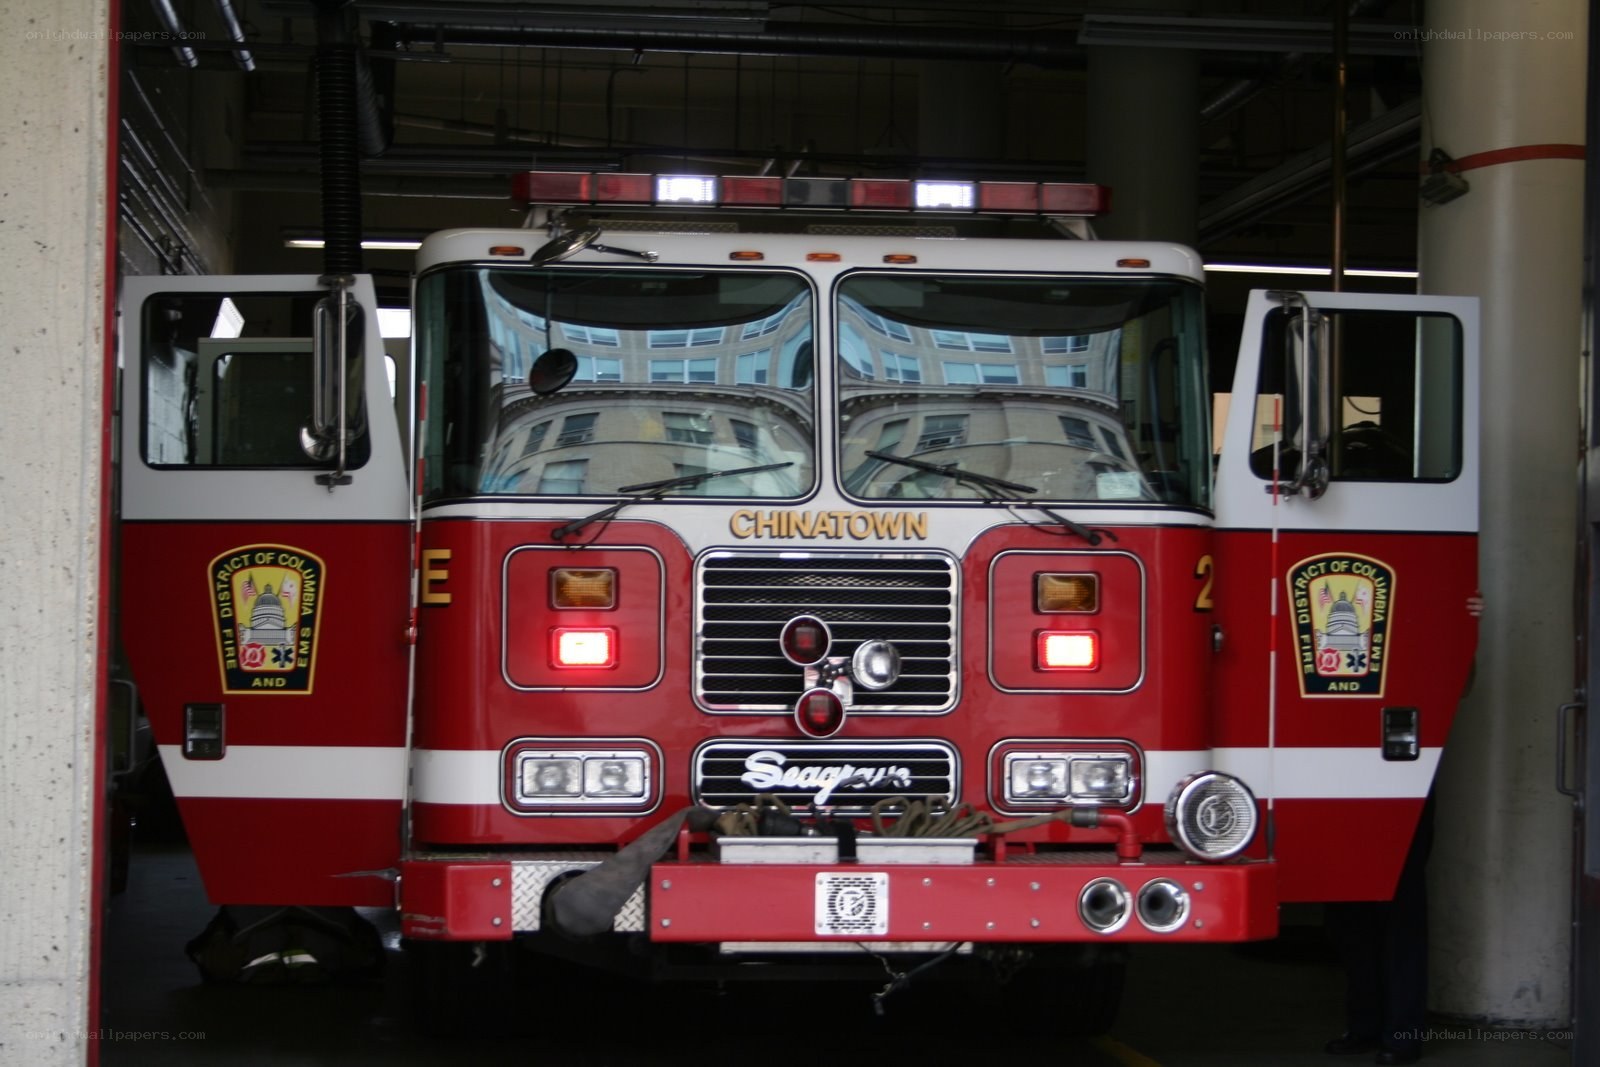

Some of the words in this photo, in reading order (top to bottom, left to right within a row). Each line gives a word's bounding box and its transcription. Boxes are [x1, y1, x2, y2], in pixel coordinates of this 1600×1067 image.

[730, 509, 929, 540] CHINATOWN
[216, 553, 250, 618] DISTRICT
[254, 552, 276, 564] OF
[277, 553, 316, 616] COLUMBIA
[422, 548, 452, 604] E
[1294, 562, 1327, 624] DISTRICT
[1330, 560, 1350, 573] OF
[1351, 561, 1388, 622] COLUMBIA
[222, 628, 238, 670] FIRE
[297, 627, 312, 668] EMS
[1300, 634, 1315, 674] FIRE
[1369, 633, 1383, 673] EMS
[251, 677, 287, 687] AND
[1327, 681, 1360, 692] AND
